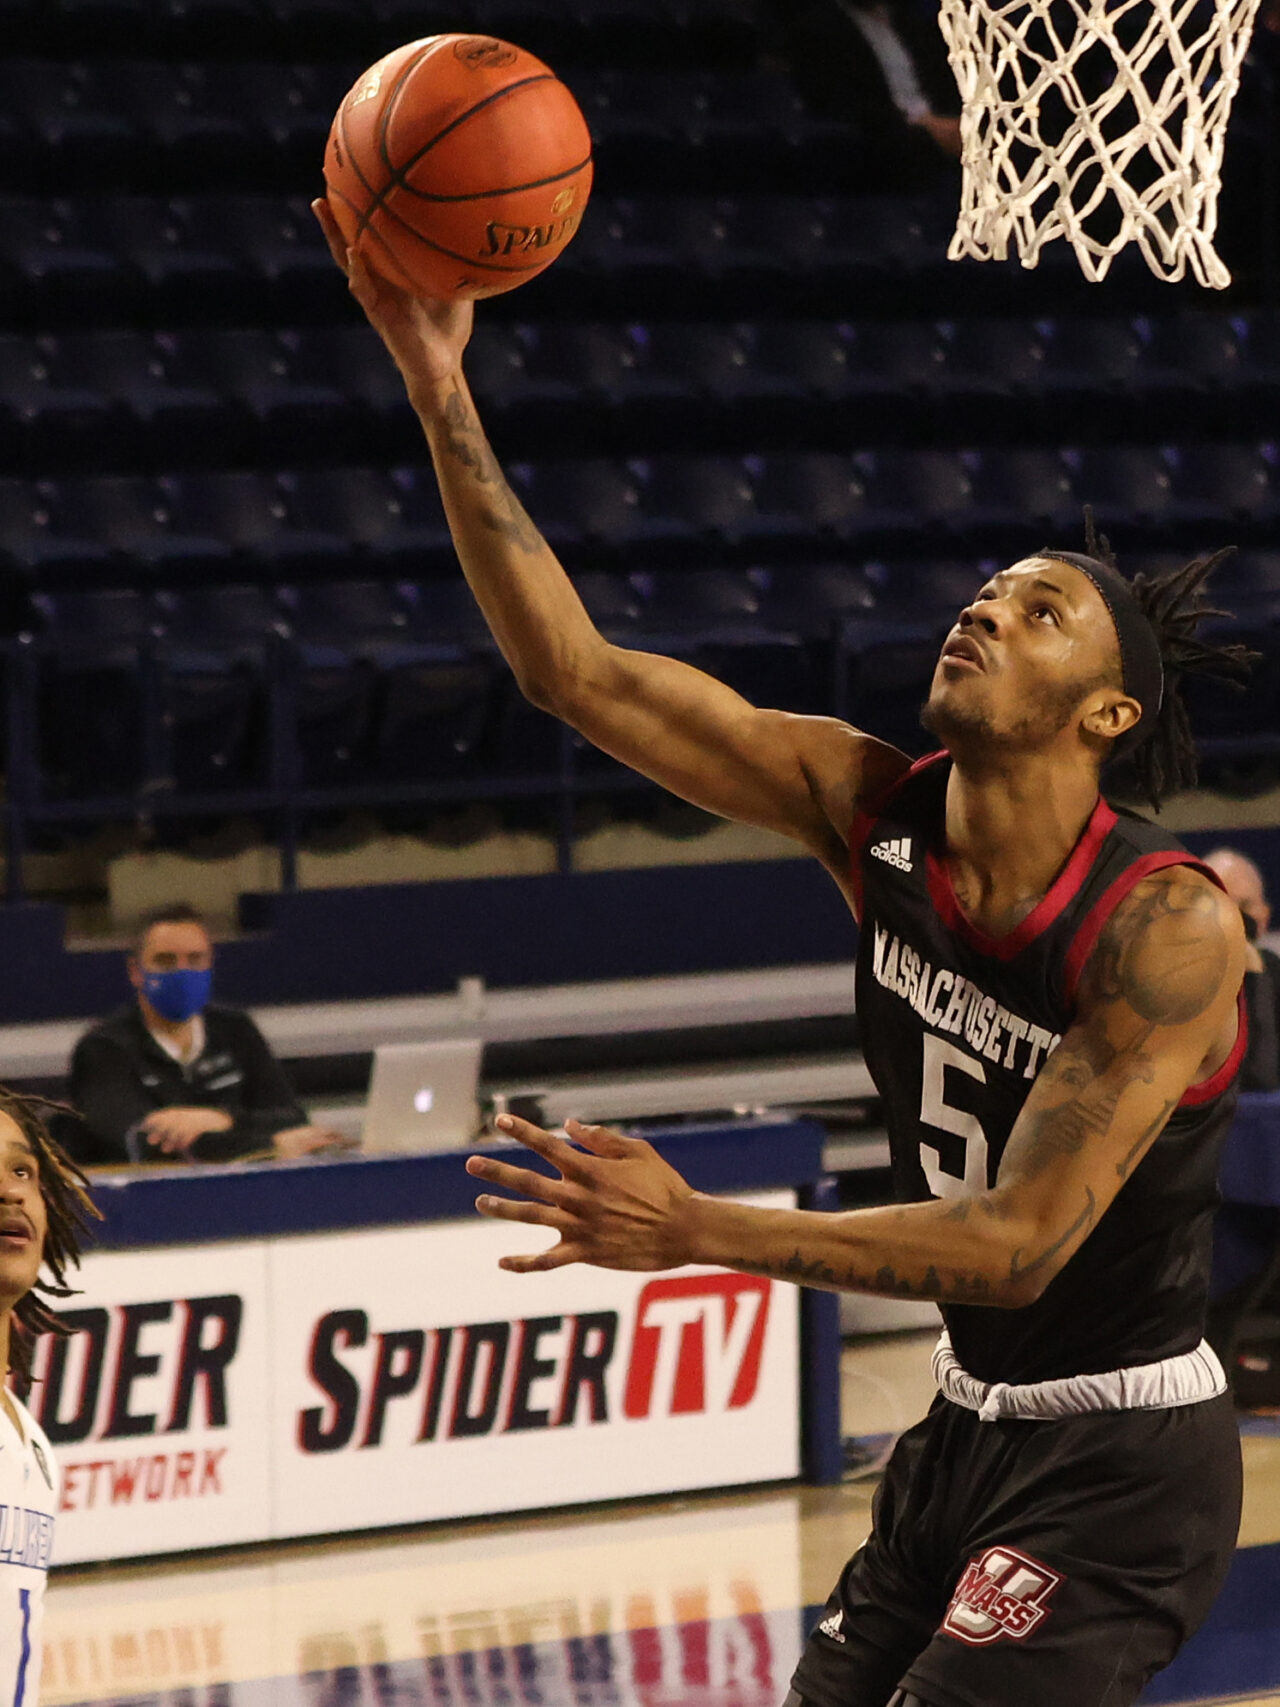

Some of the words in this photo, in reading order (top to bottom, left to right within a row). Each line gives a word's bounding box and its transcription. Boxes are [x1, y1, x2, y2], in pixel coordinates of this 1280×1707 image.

[870, 845, 914, 873] adidas
[919, 1031, 989, 1201] 5
[20, 1294, 242, 1447] DER
[296, 1308, 619, 1456] SPIDER
[638, 1288, 766, 1420] TV
[58, 1448, 228, 1512] ETWORK
